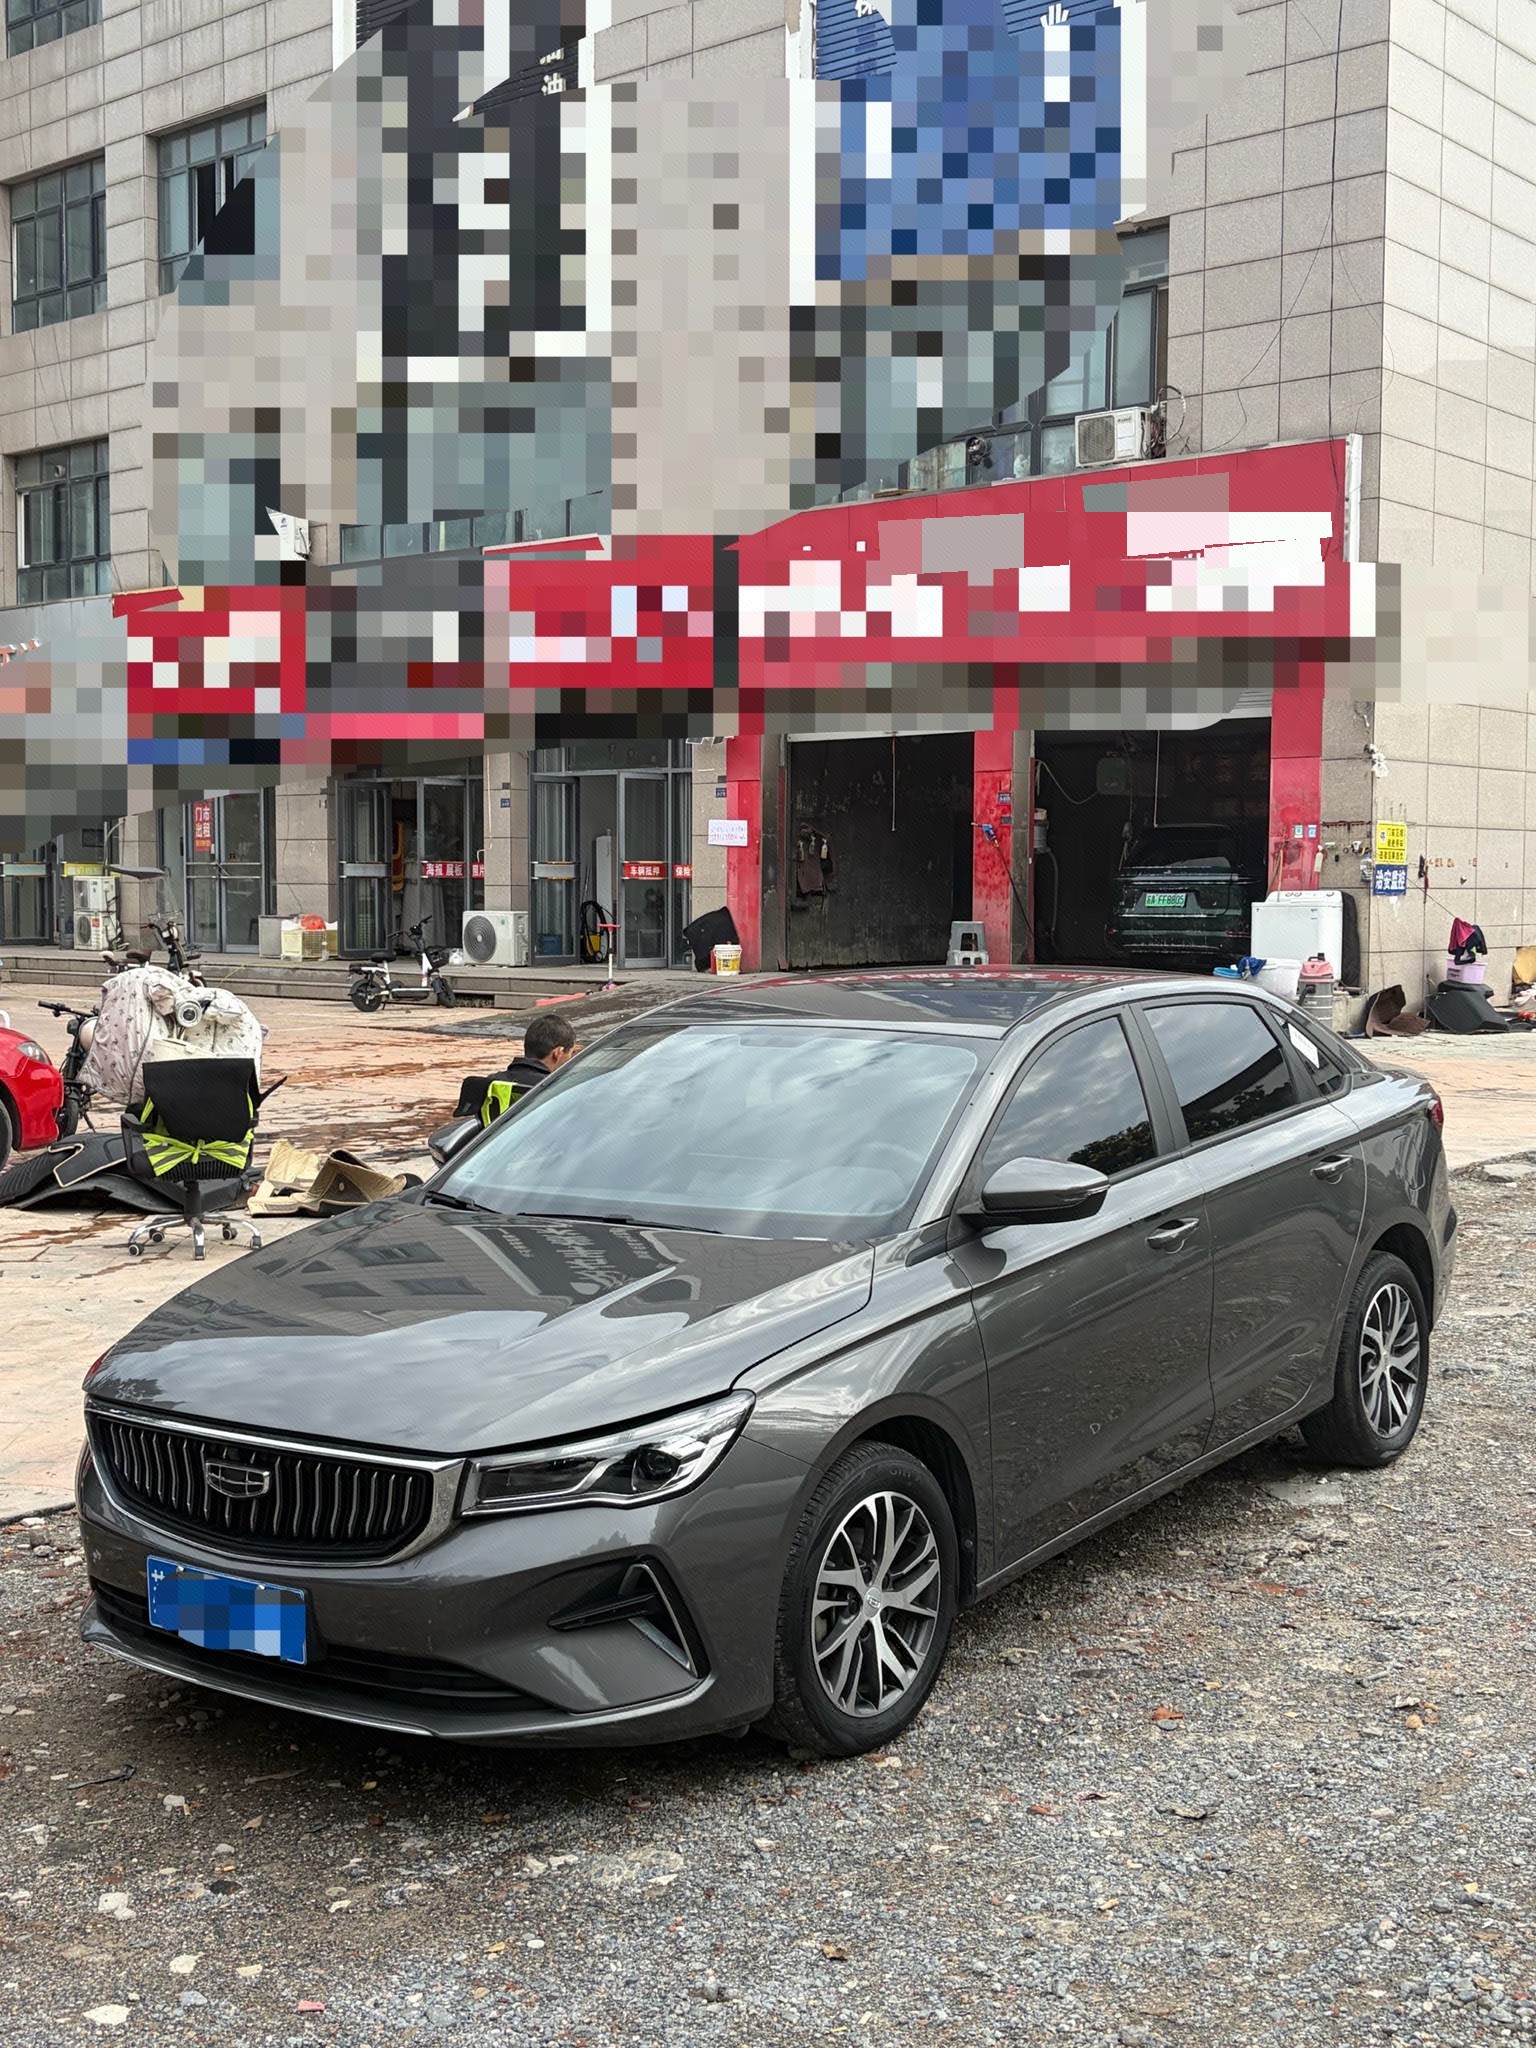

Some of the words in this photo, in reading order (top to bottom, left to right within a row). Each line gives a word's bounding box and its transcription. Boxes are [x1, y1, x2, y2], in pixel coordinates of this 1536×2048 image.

[195, 806, 210, 821] 门市
[195, 823, 210, 837] 出租
[426, 863, 443, 876] 海报
[446, 863, 463, 876] 展板
[630, 866, 660, 876] 车辆抵押
[675, 866, 691, 876] 保险
[1375, 869, 1406, 890] 治安监控
